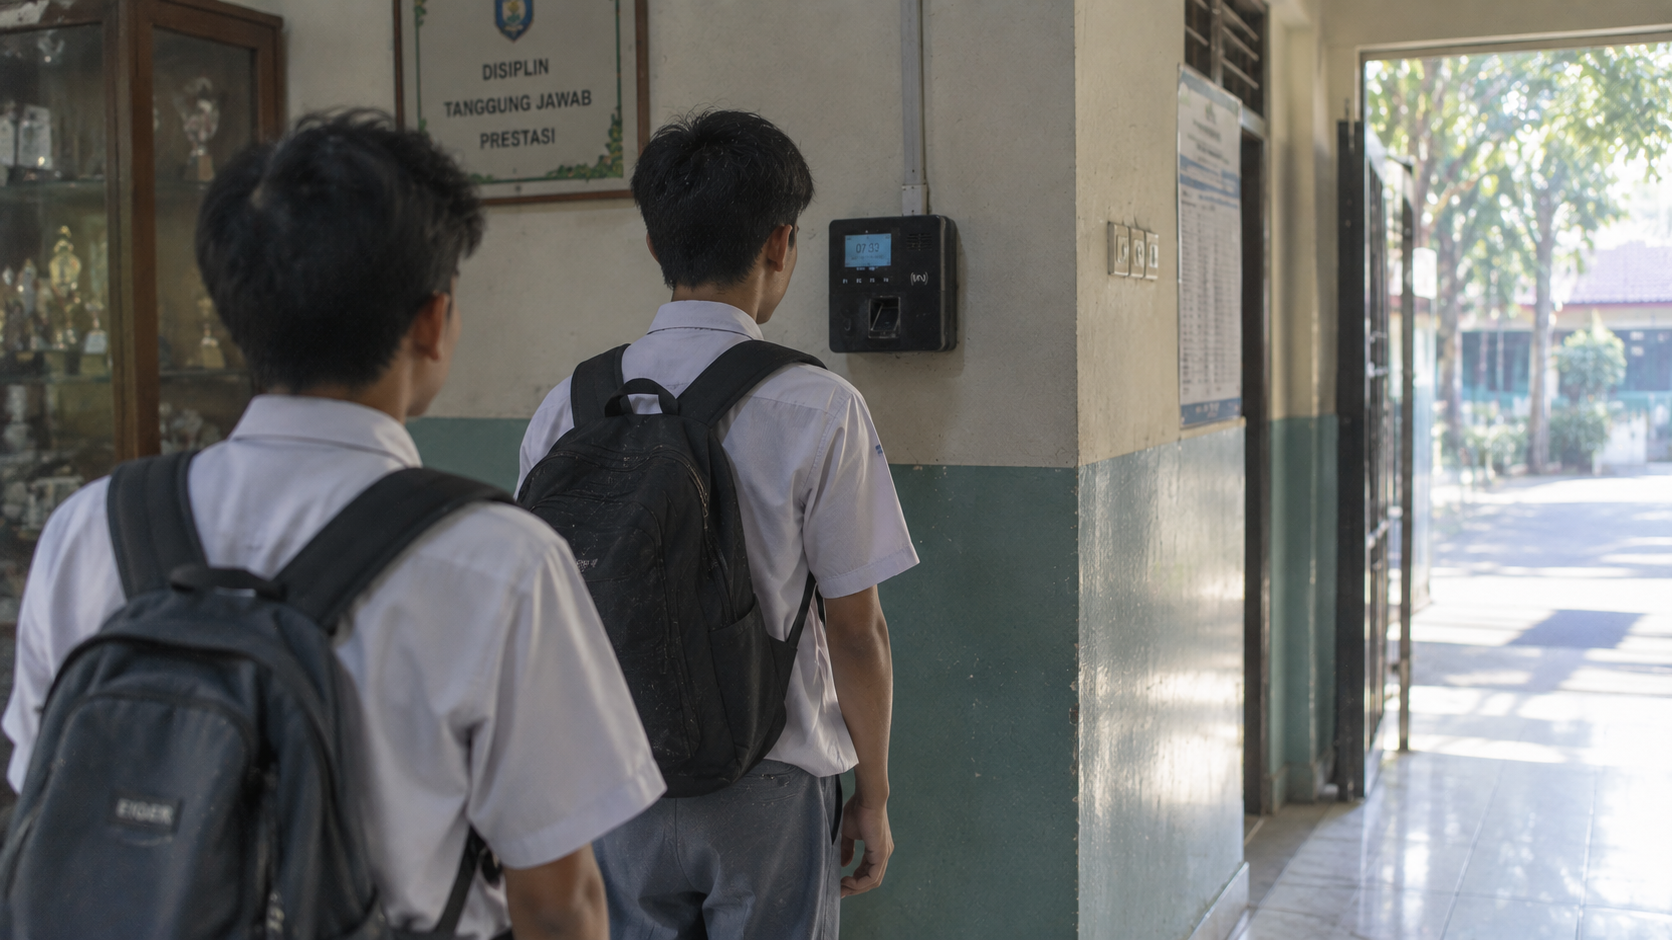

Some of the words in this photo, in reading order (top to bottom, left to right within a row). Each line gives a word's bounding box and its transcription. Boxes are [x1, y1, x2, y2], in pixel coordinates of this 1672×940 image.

[482, 58, 549, 81] DISIPLIN
[444, 95, 531, 118] TANGGUNG
[536, 90, 592, 110] JAWAB
[480, 128, 556, 149] PRESTASI
